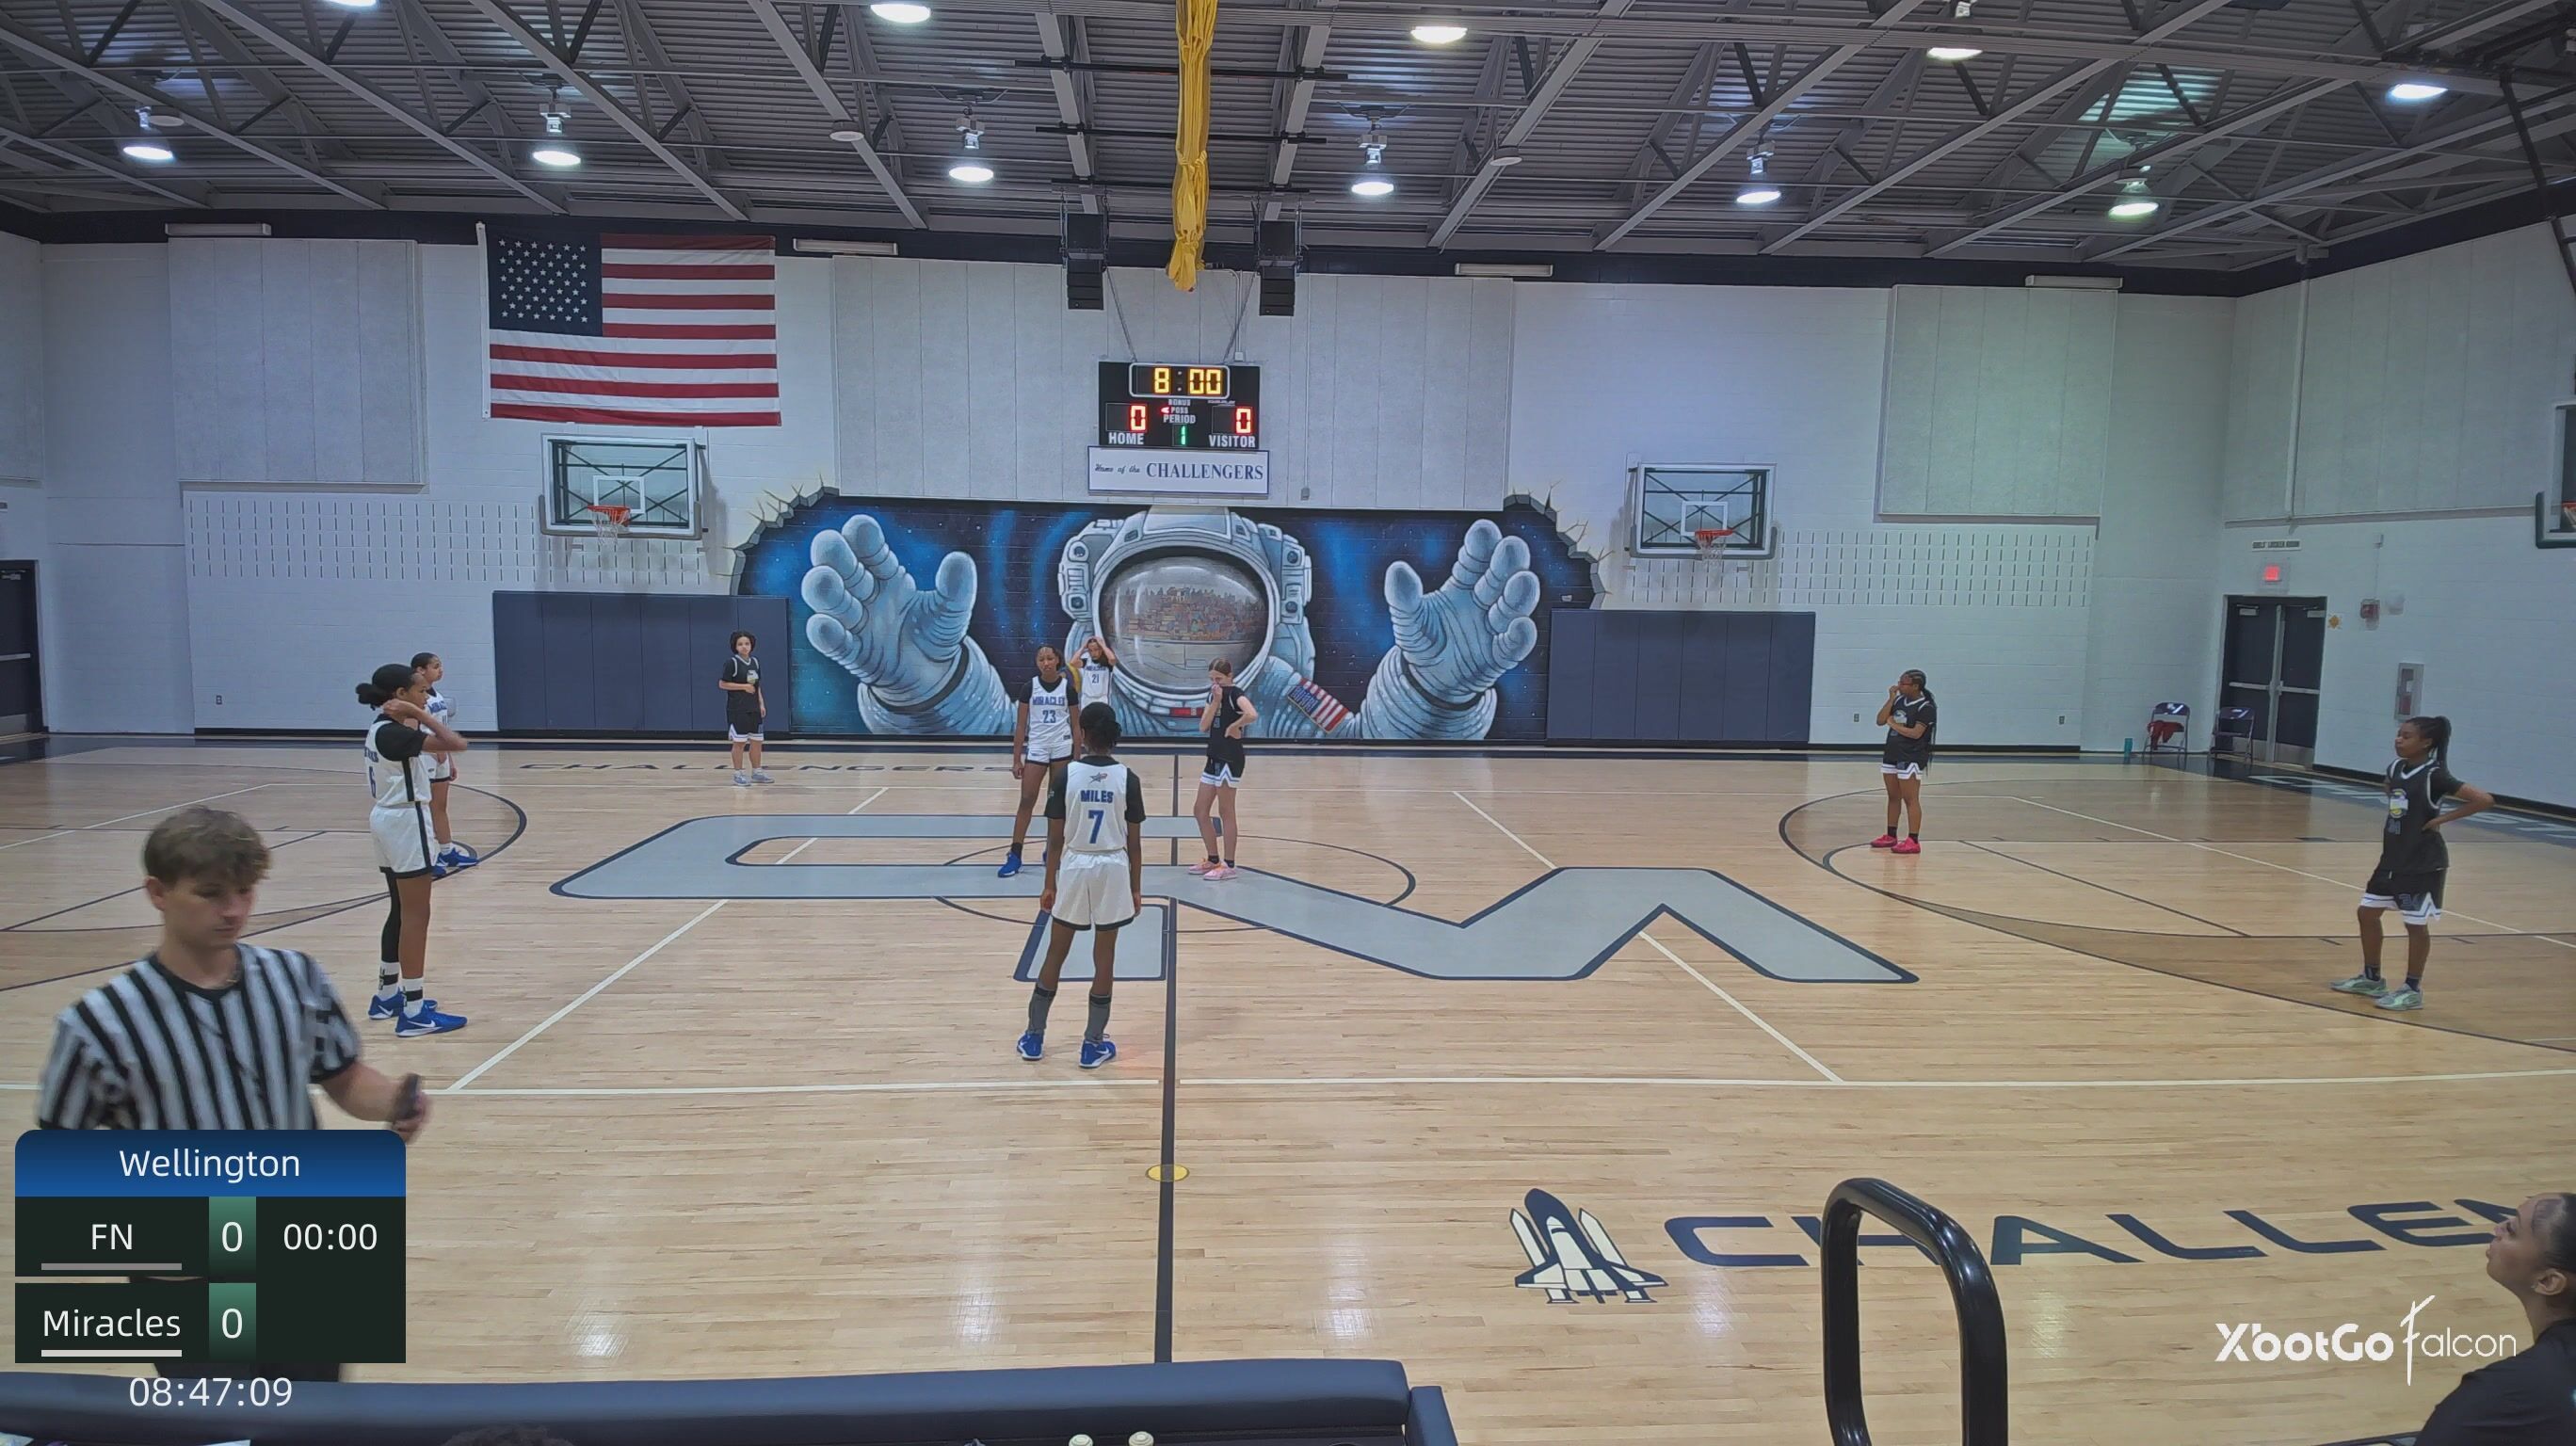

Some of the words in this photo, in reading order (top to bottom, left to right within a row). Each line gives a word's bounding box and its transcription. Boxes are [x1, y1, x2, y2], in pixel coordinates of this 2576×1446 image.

[1154, 367, 1221, 394] 8:00
[1130, 405, 1146, 431] 0
[1163, 414, 1196, 424] PERIOD
[1235, 408, 1251, 434] 0
[1108, 432, 1144, 445] HOME
[1181, 425, 1186, 445] 1
[1209, 434, 1256, 448] VISITOR
[1095, 463, 1114, 472] Home
[1118, 465, 1125, 474] of
[1129, 464, 1140, 473] the
[1146, 462, 1264, 480] CHALLENGERS
[1091, 673, 1100, 683] 21
[1042, 710, 1056, 723] 23
[1080, 790, 1114, 803] MILES
[1087, 810, 1104, 844] 7
